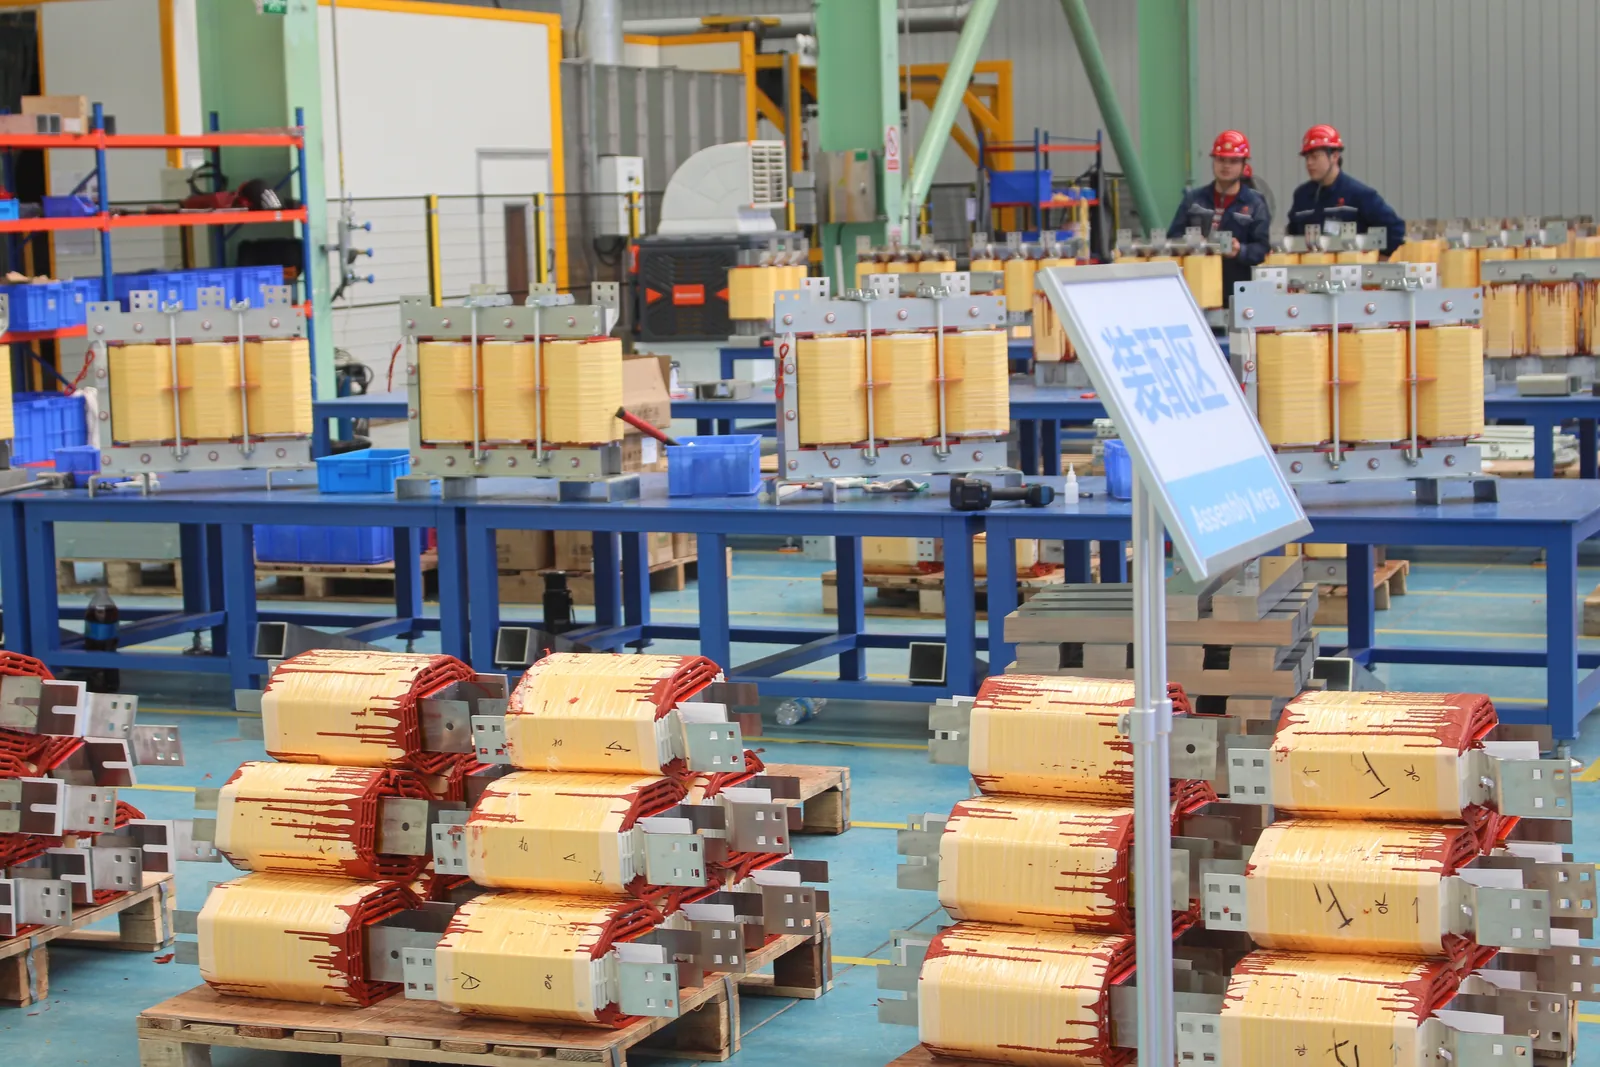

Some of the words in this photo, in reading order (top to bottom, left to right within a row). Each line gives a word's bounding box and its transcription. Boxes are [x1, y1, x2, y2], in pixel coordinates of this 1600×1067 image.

[1100, 323, 1229, 425] 装配区
[1190, 490, 1256, 534] Assembly
[1247, 487, 1280, 514] Area
